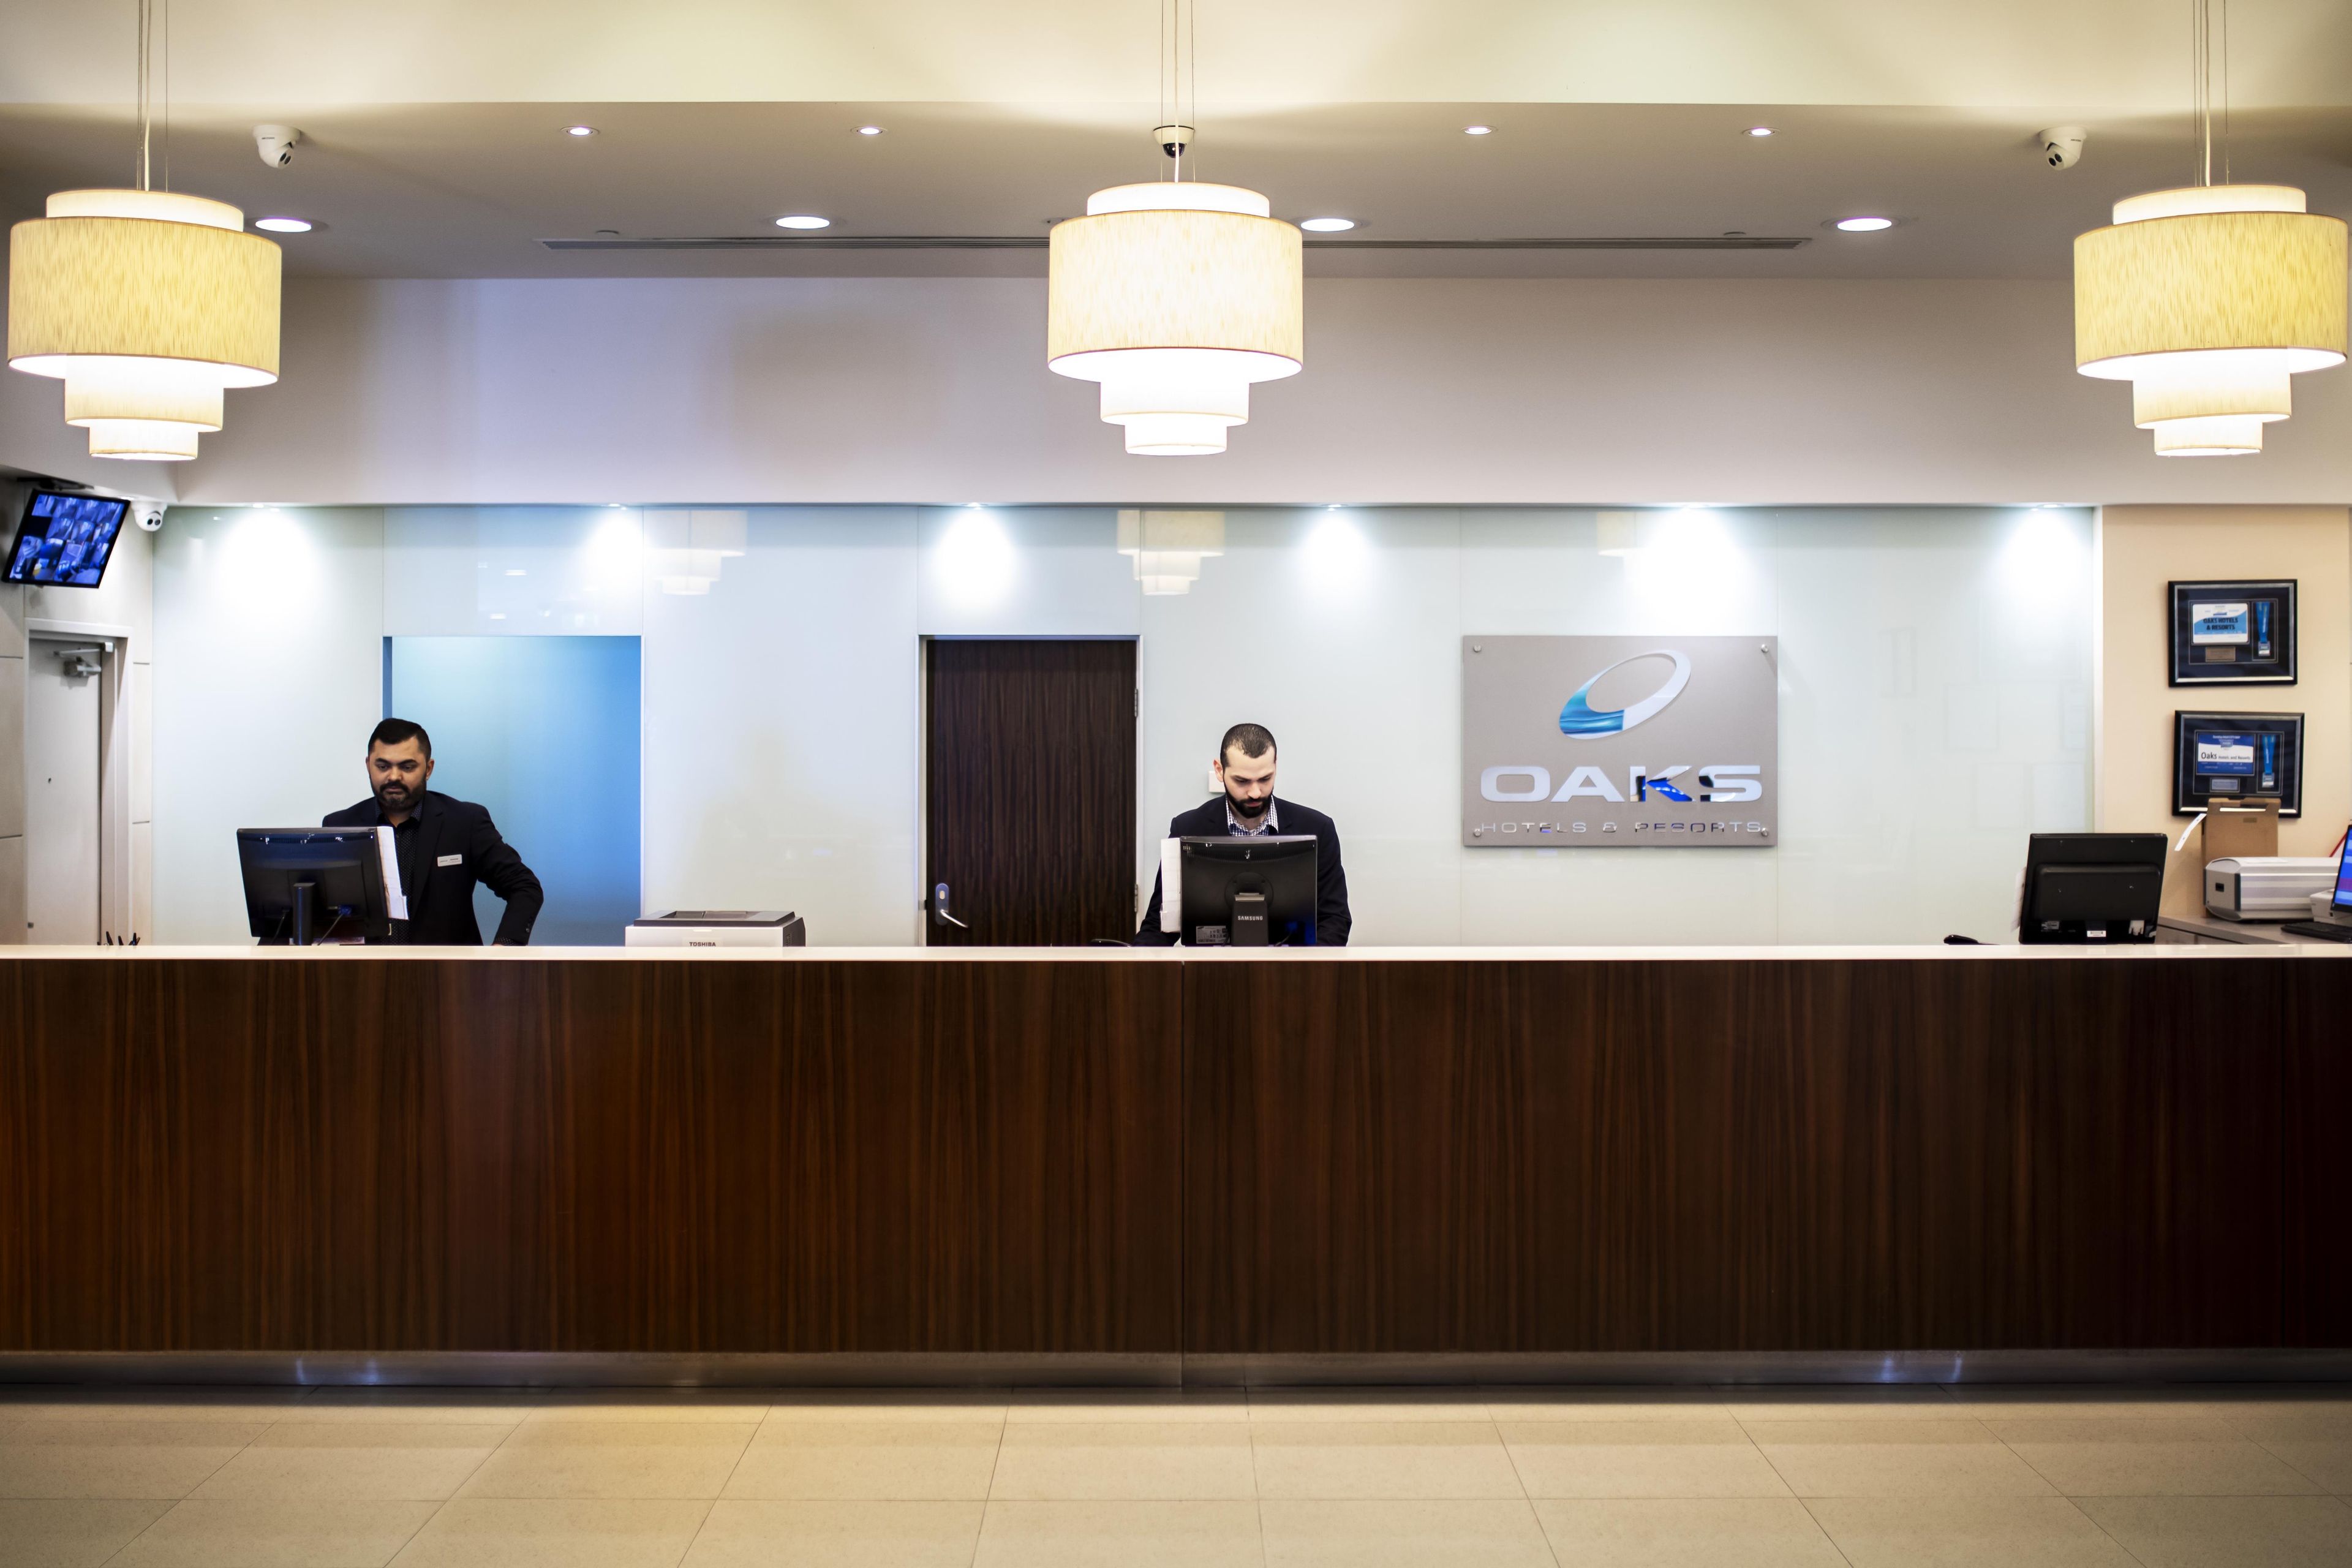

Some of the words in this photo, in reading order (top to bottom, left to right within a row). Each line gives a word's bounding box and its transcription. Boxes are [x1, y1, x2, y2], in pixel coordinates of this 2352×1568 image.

[1480, 766, 1762, 802] OAKS
[1482, 823, 1586, 833] HOTELS
[1602, 822, 1617, 833] &
[1635, 822, 1760, 833] RESORTS
